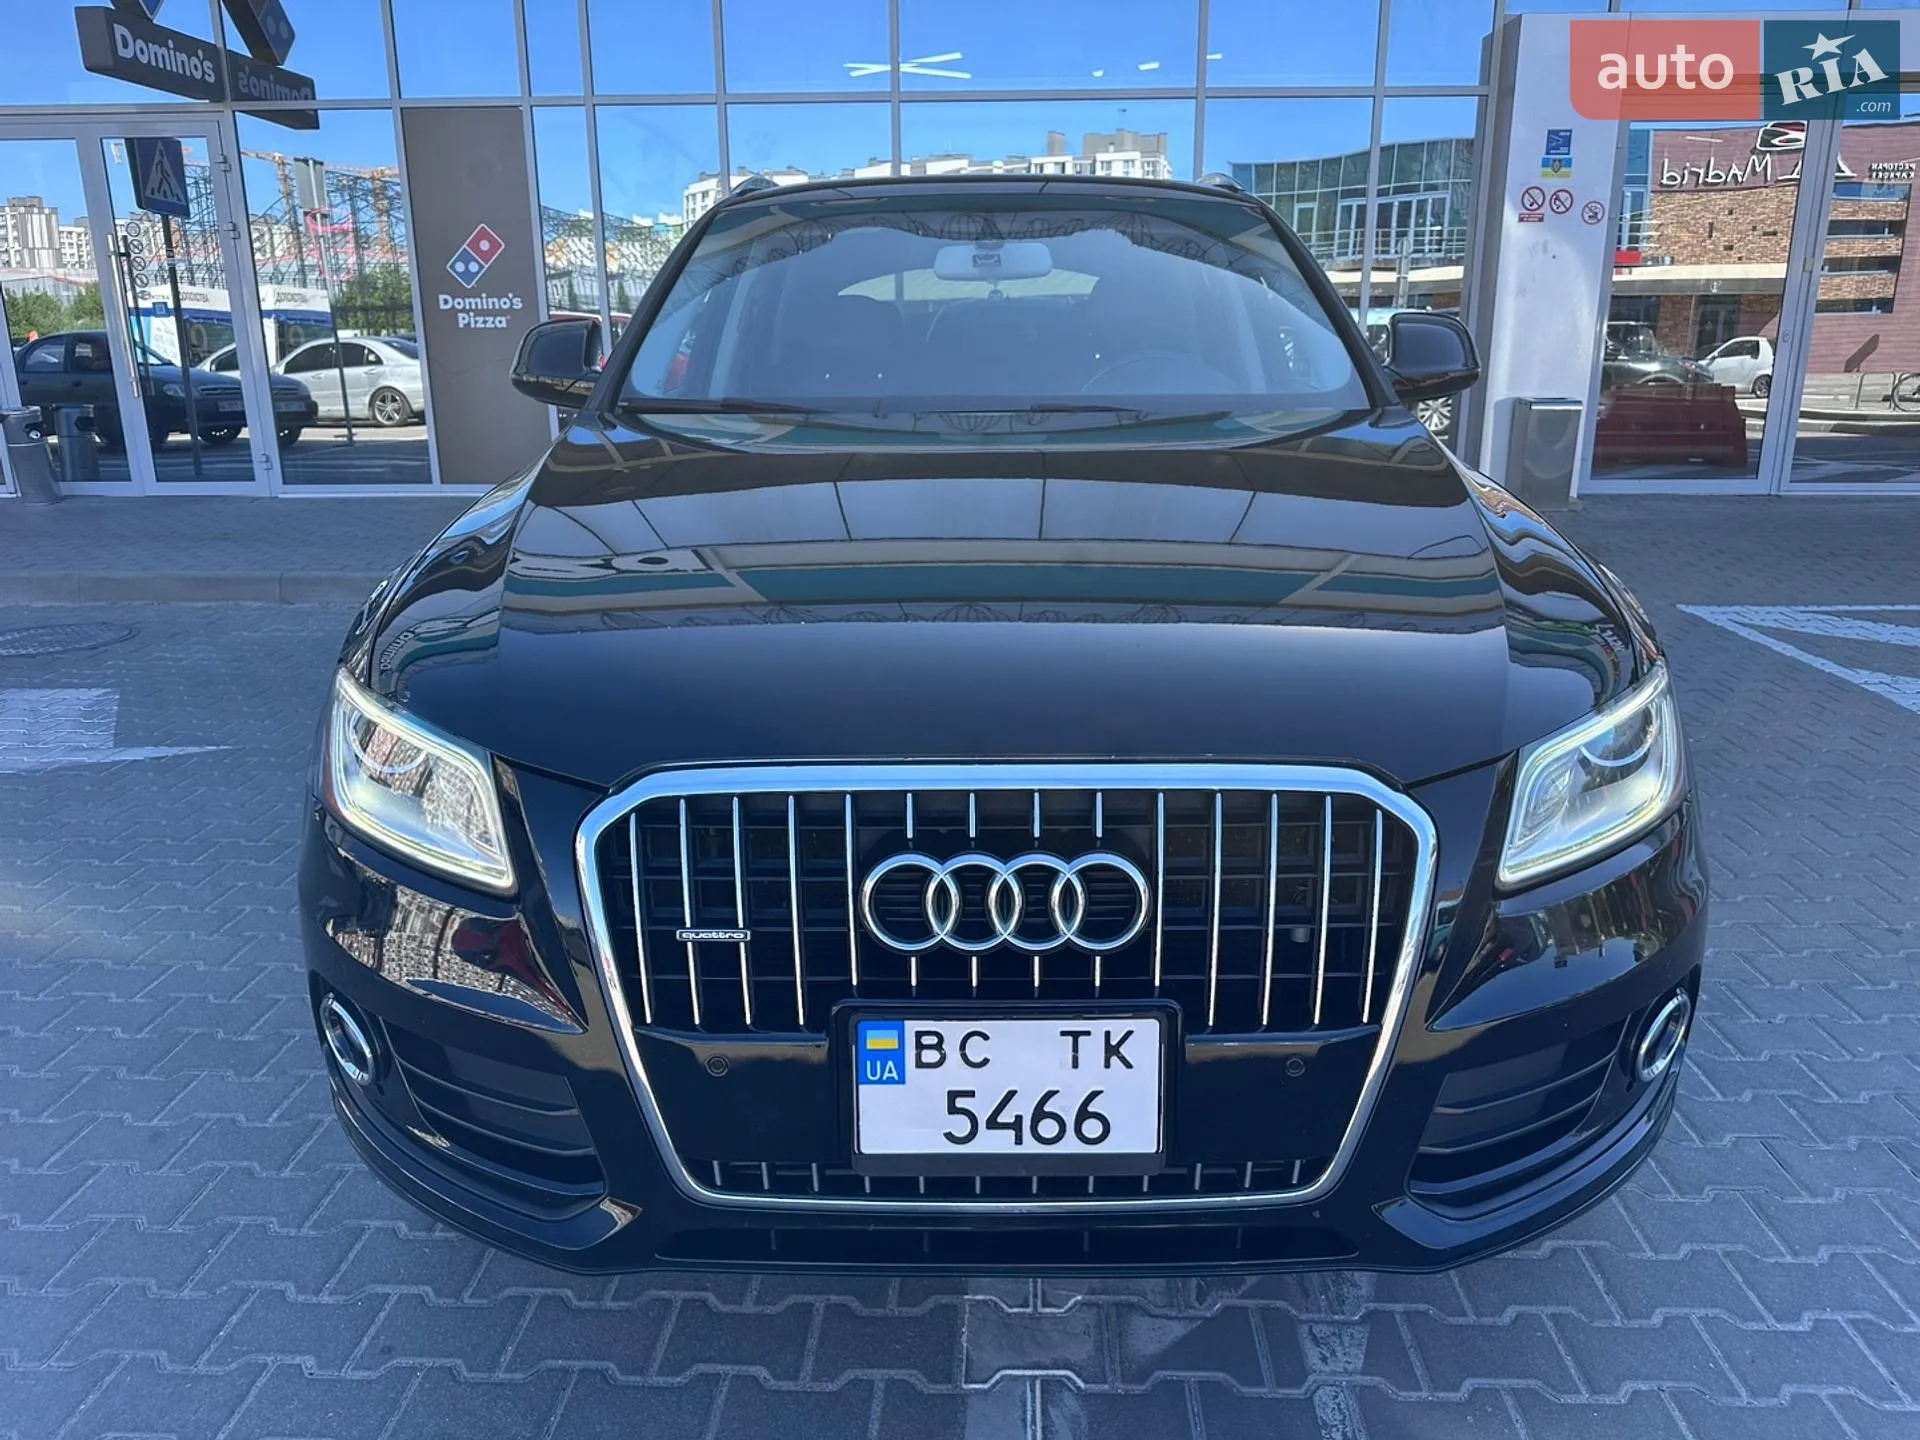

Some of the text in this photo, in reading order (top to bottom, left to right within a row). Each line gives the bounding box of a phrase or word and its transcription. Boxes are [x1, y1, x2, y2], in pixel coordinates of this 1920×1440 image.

[113, 23, 215, 84] Domino's
[438, 292, 523, 310] Domino's
[457, 311, 508, 328] Pizza
[914, 1030, 1134, 1070] BC TK
[866, 1060, 898, 1081] UA
[943, 1089, 1111, 1146] 5466
